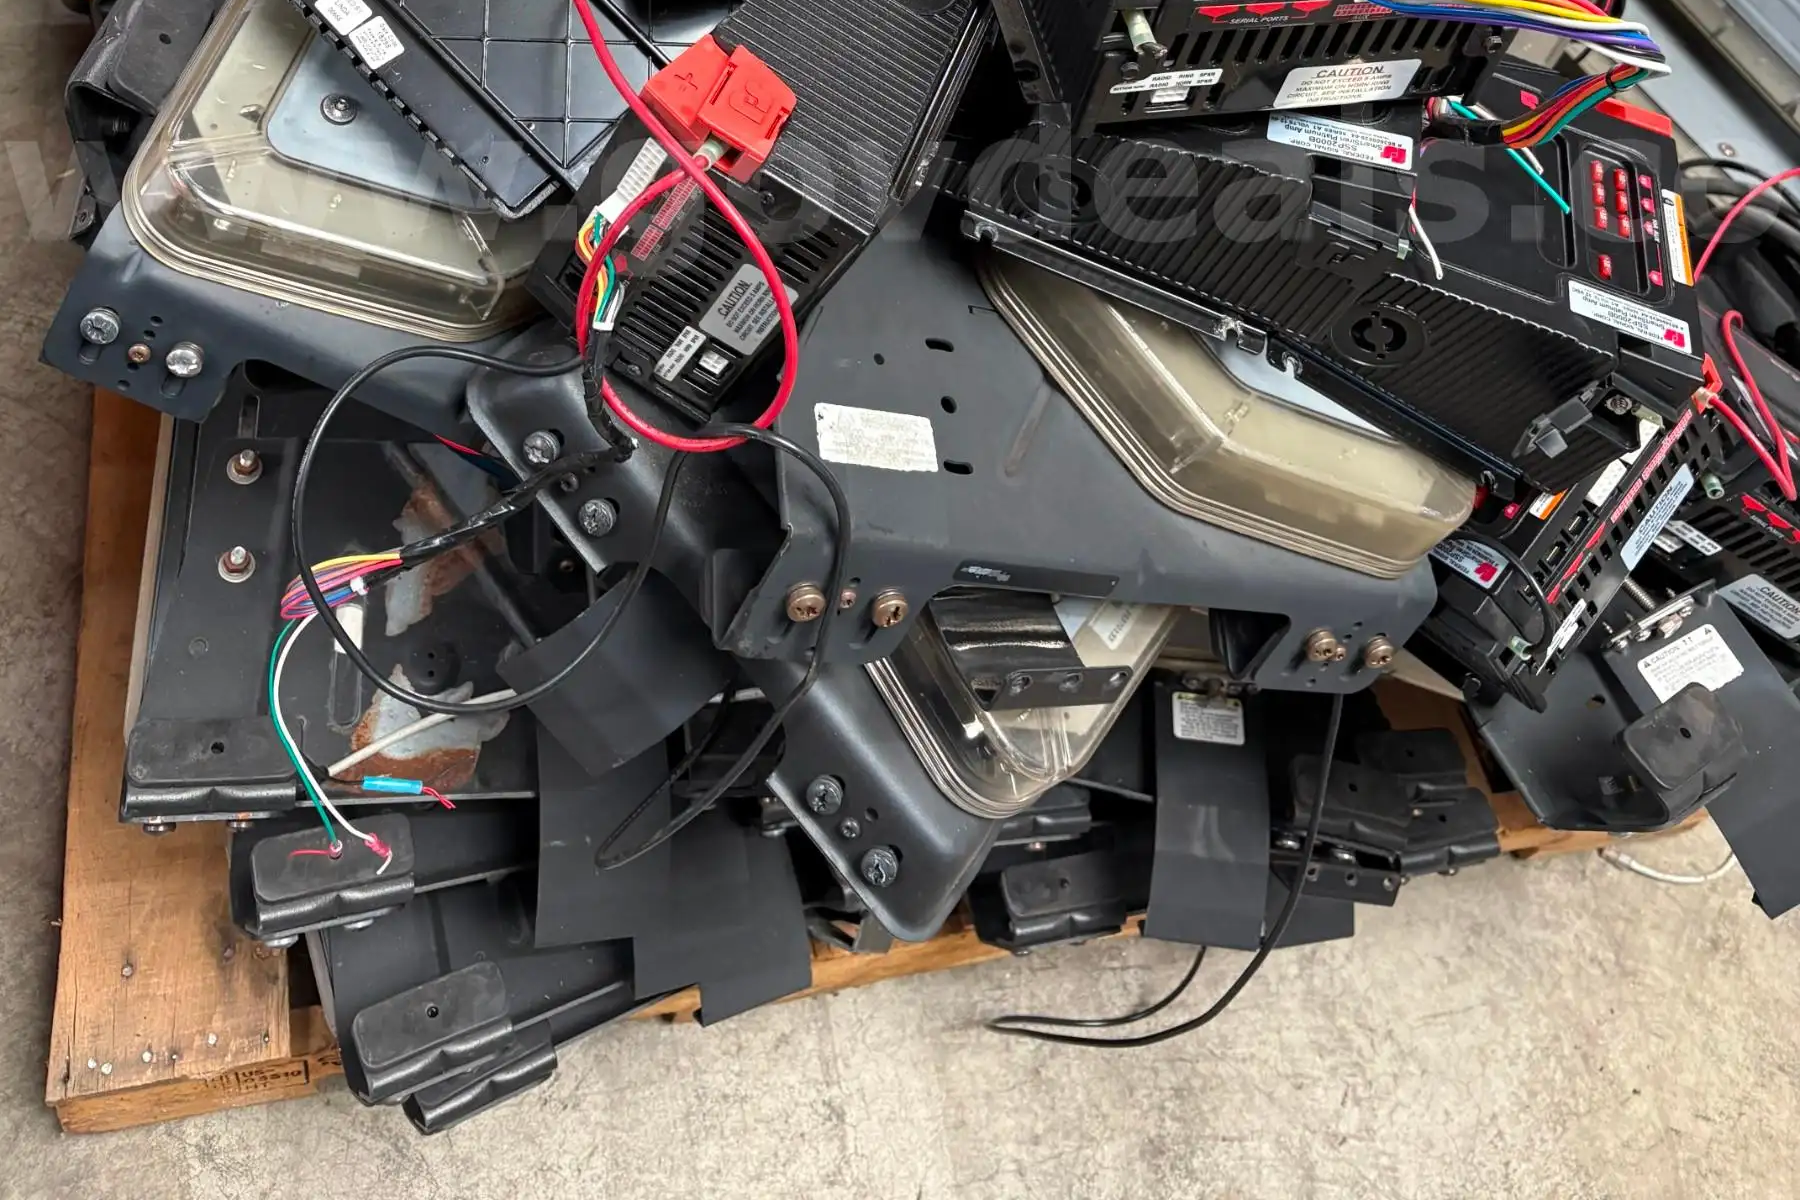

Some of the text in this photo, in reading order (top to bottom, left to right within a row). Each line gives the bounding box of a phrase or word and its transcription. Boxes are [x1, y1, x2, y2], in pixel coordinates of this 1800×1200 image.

[1315, 64, 1385, 78] CAUTION
[1294, 84, 1334, 92] MAXIMUM
[1283, 123, 1302, 133] Amp
[1304, 128, 1337, 140] Platinum
[1308, 135, 1357, 151] SSP2000B
[1338, 135, 1382, 149] SmartSiren
[1342, 149, 1373, 160] FEDERAL
[716, 278, 751, 317] CAUTION
[1607, 310, 1648, 329] SSP2000B
[1638, 481, 1673, 535] CAUTION
[1649, 644, 1680, 664] CAUTION
